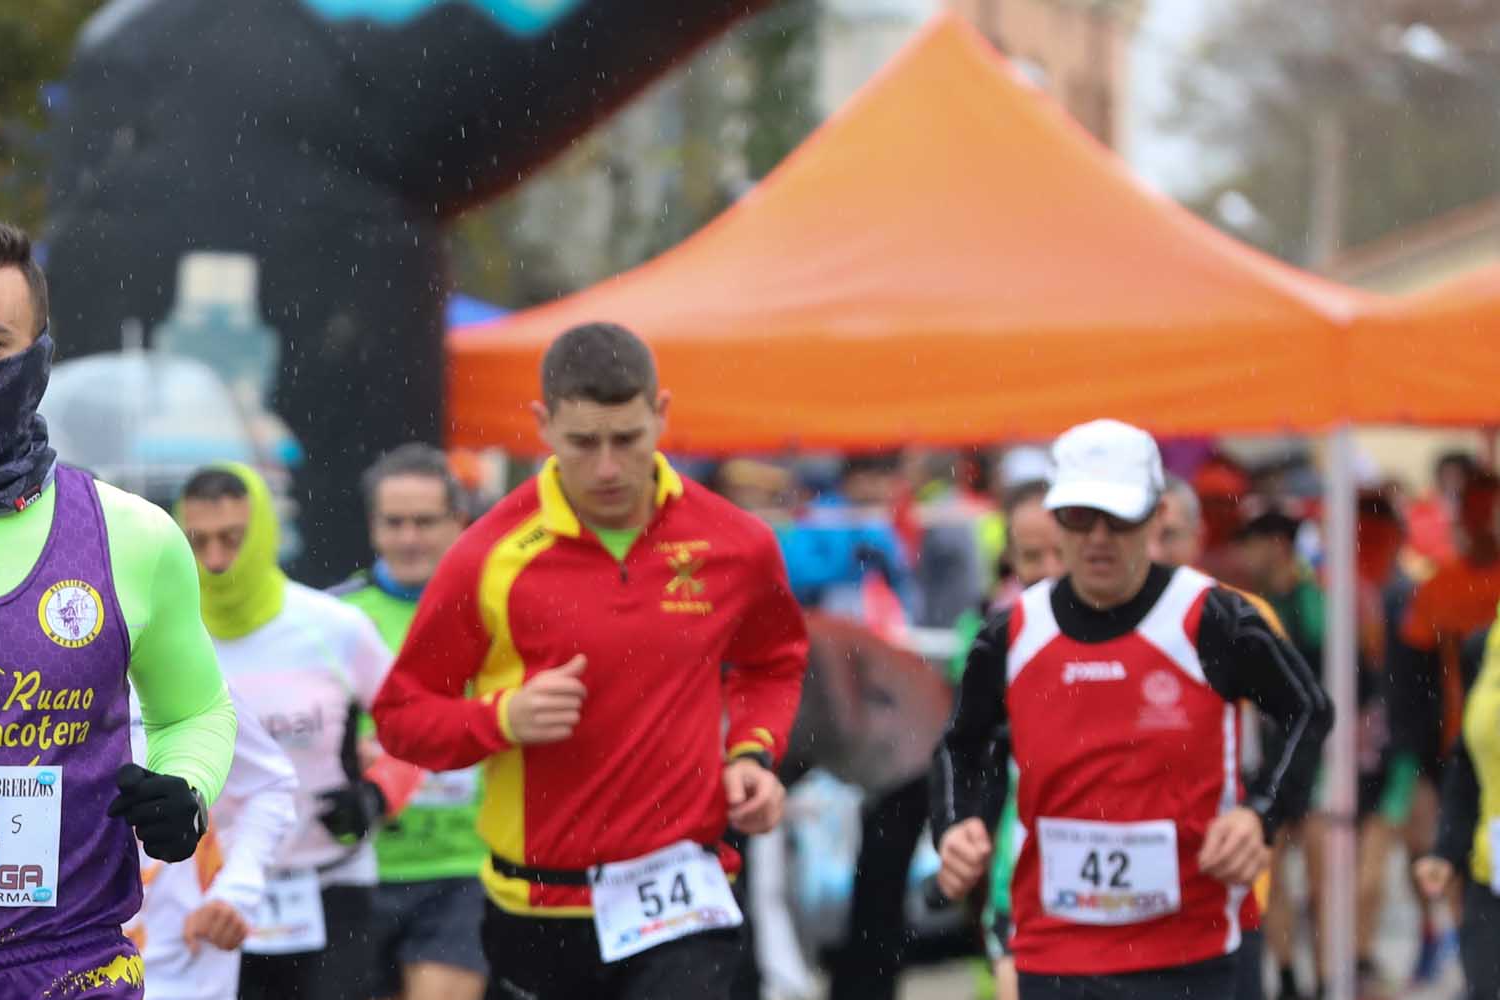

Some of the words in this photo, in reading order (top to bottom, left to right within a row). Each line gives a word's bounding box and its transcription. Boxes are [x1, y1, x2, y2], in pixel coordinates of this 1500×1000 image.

[2, 670, 94, 711] Ruano
[1081, 849, 1132, 887] 42
[637, 872, 693, 918] 54
